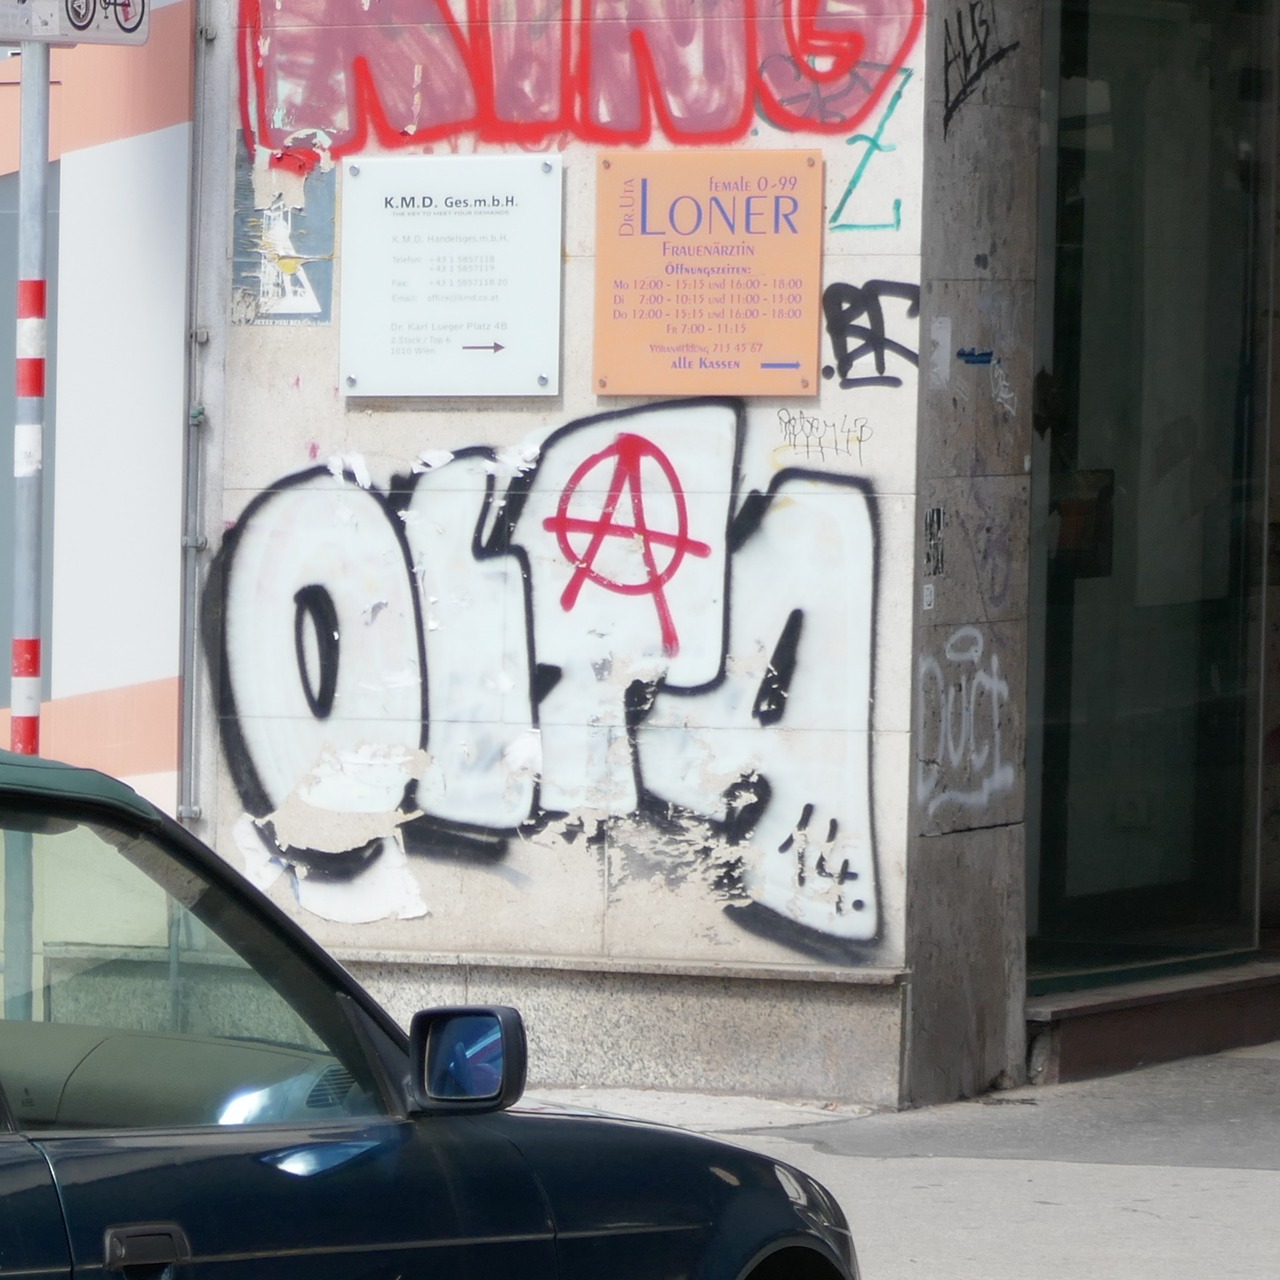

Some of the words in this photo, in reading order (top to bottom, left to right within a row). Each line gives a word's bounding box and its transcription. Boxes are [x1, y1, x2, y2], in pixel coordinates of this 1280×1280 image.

[384, 196, 438, 209] K.M.D.
[444, 195, 519, 208] Ges.m.b.H.
[640, 178, 799, 236] LONER
